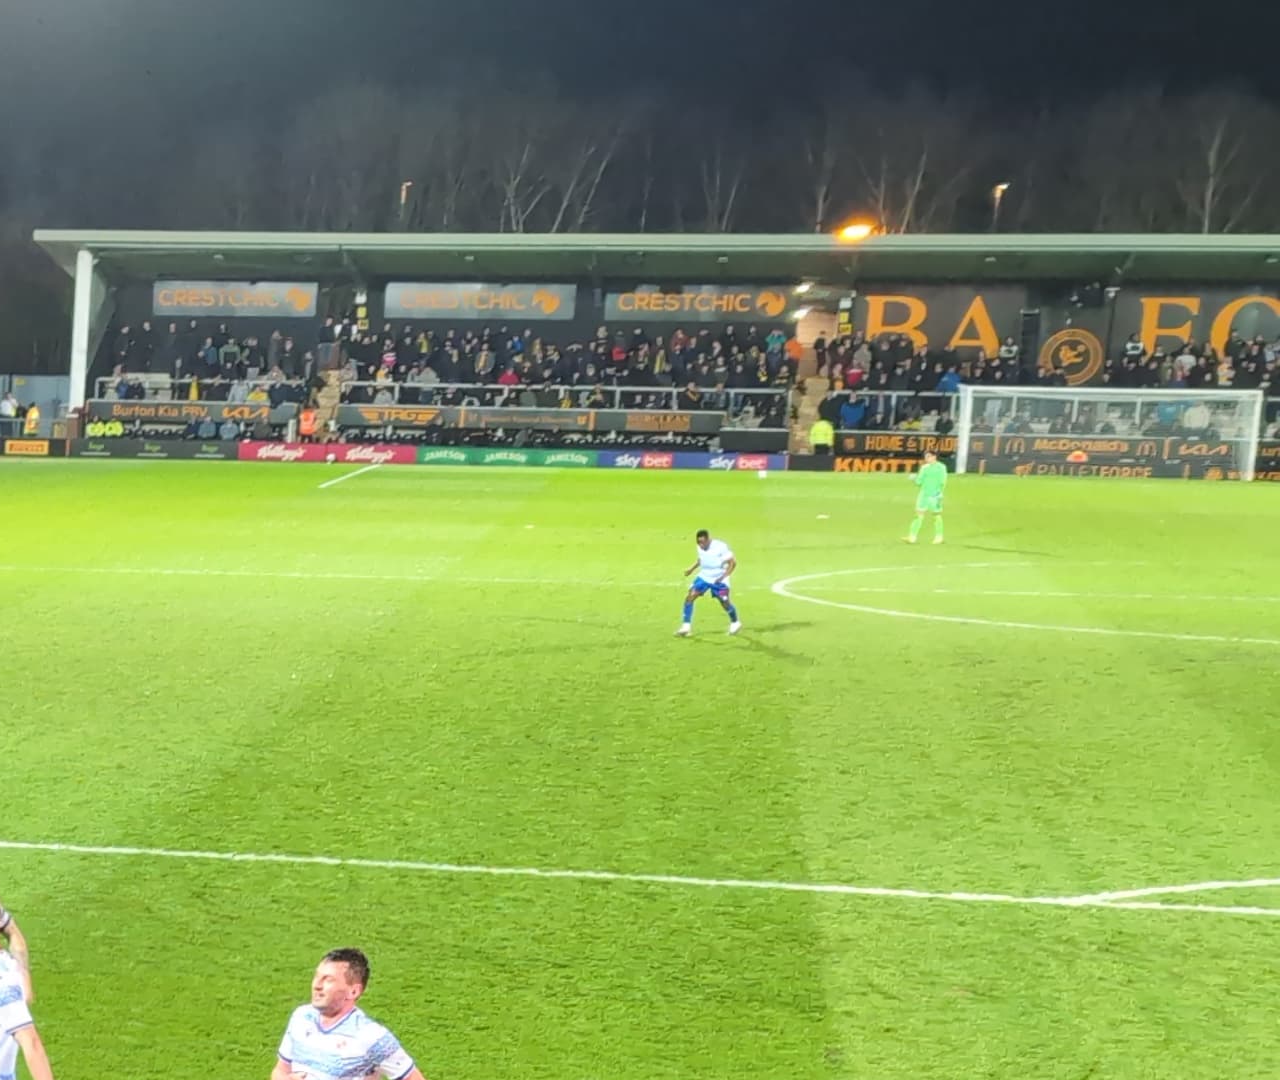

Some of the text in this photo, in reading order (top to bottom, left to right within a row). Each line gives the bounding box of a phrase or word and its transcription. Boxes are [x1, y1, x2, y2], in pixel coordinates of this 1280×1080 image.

[159, 288, 280, 308] CRESTCHIC
[400, 289, 527, 310] CRESTCHIC
[618, 291, 752, 313] CRESTCHIC
[112, 404, 153, 417] Burton
[157, 404, 179, 417] Kia
[865, 434, 903, 450] HOME
[919, 435, 960, 451] TRAD
[1033, 438, 1129, 452] McDonald's
[256, 444, 308, 462] Kellogg's
[345, 445, 397, 463] Kellogg's
[424, 450, 468, 462] JAMESON
[484, 451, 529, 464] JAMESON
[545, 453, 589, 465] JAMESON
[615, 453, 672, 469] sky bet
[709, 454, 767, 471] sky bet
[833, 457, 924, 473] KNOTT
[1036, 464, 1153, 478] PALLETFORCE
